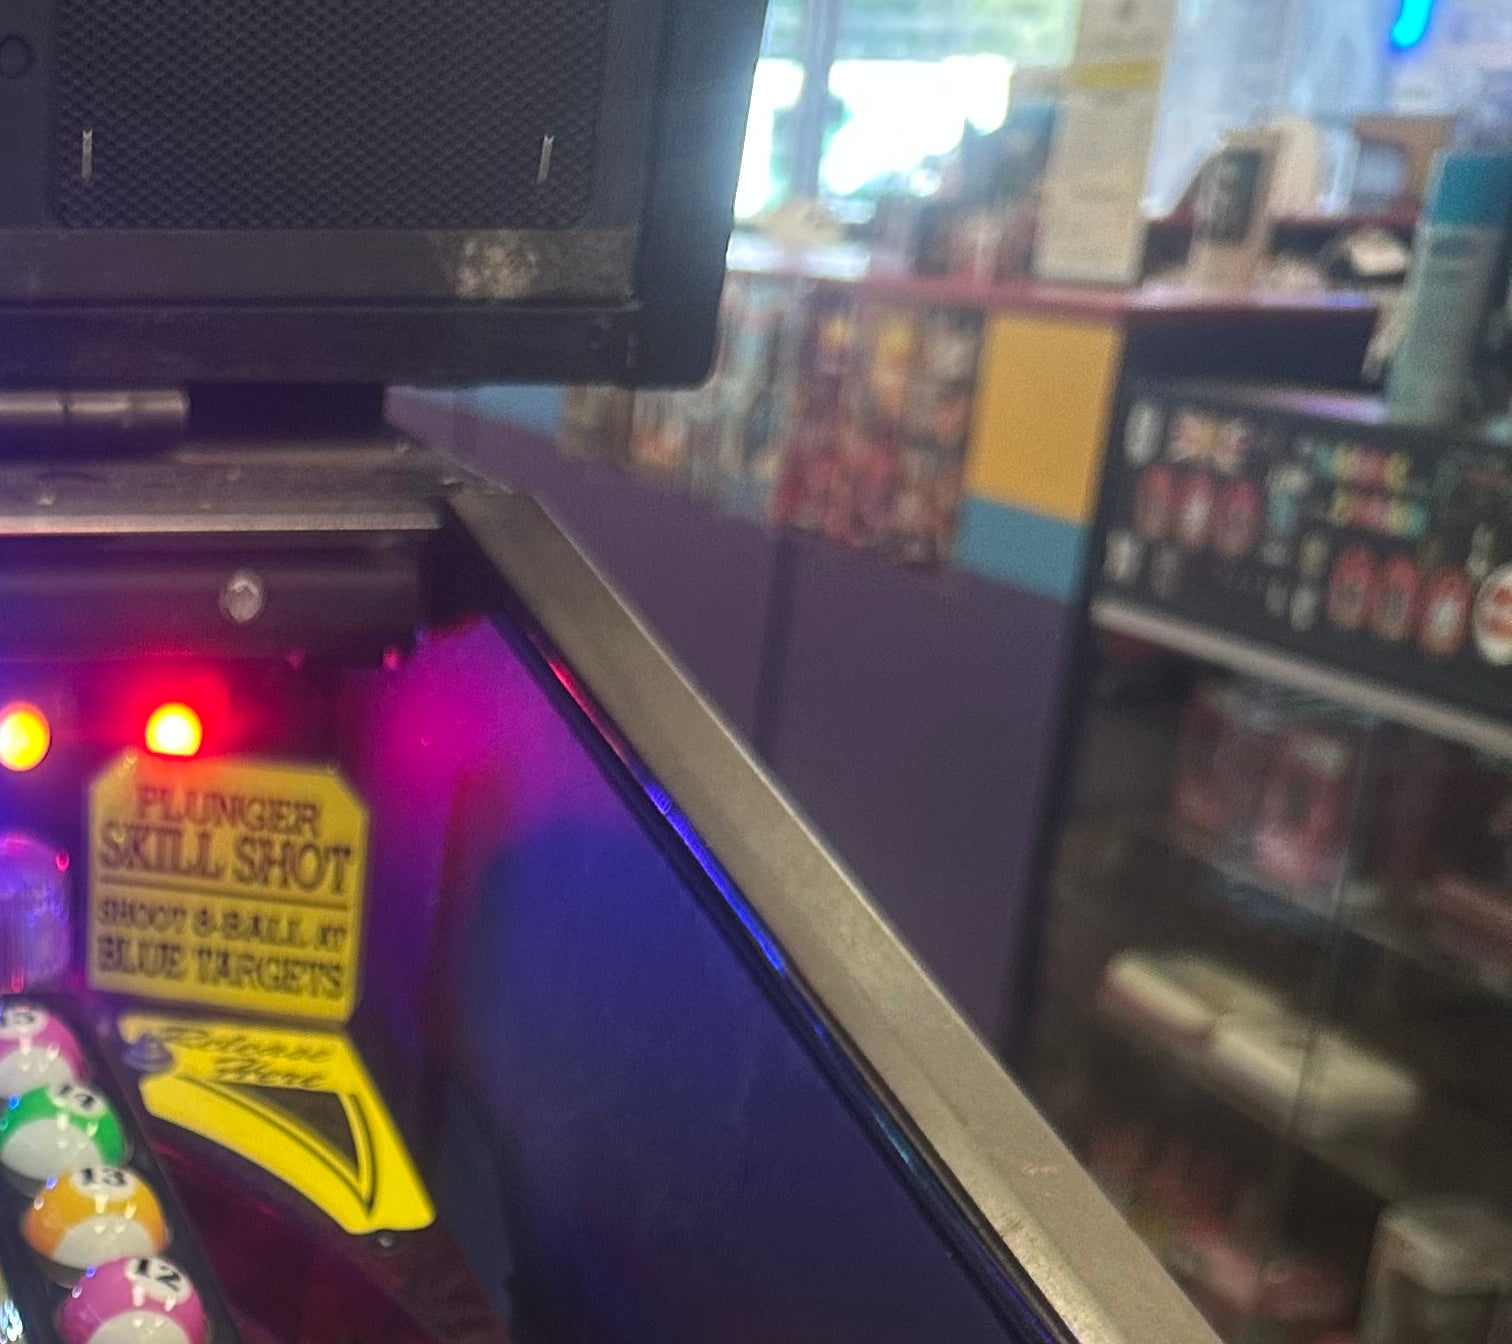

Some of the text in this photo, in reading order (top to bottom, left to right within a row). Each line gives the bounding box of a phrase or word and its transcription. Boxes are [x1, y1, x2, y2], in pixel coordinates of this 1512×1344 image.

[137, 784, 320, 837] PLUNGER
[98, 818, 352, 896] SKILL SHOT
[98, 935, 344, 1001] BLUE TARGETS
[134, 1256, 182, 1293] 12
